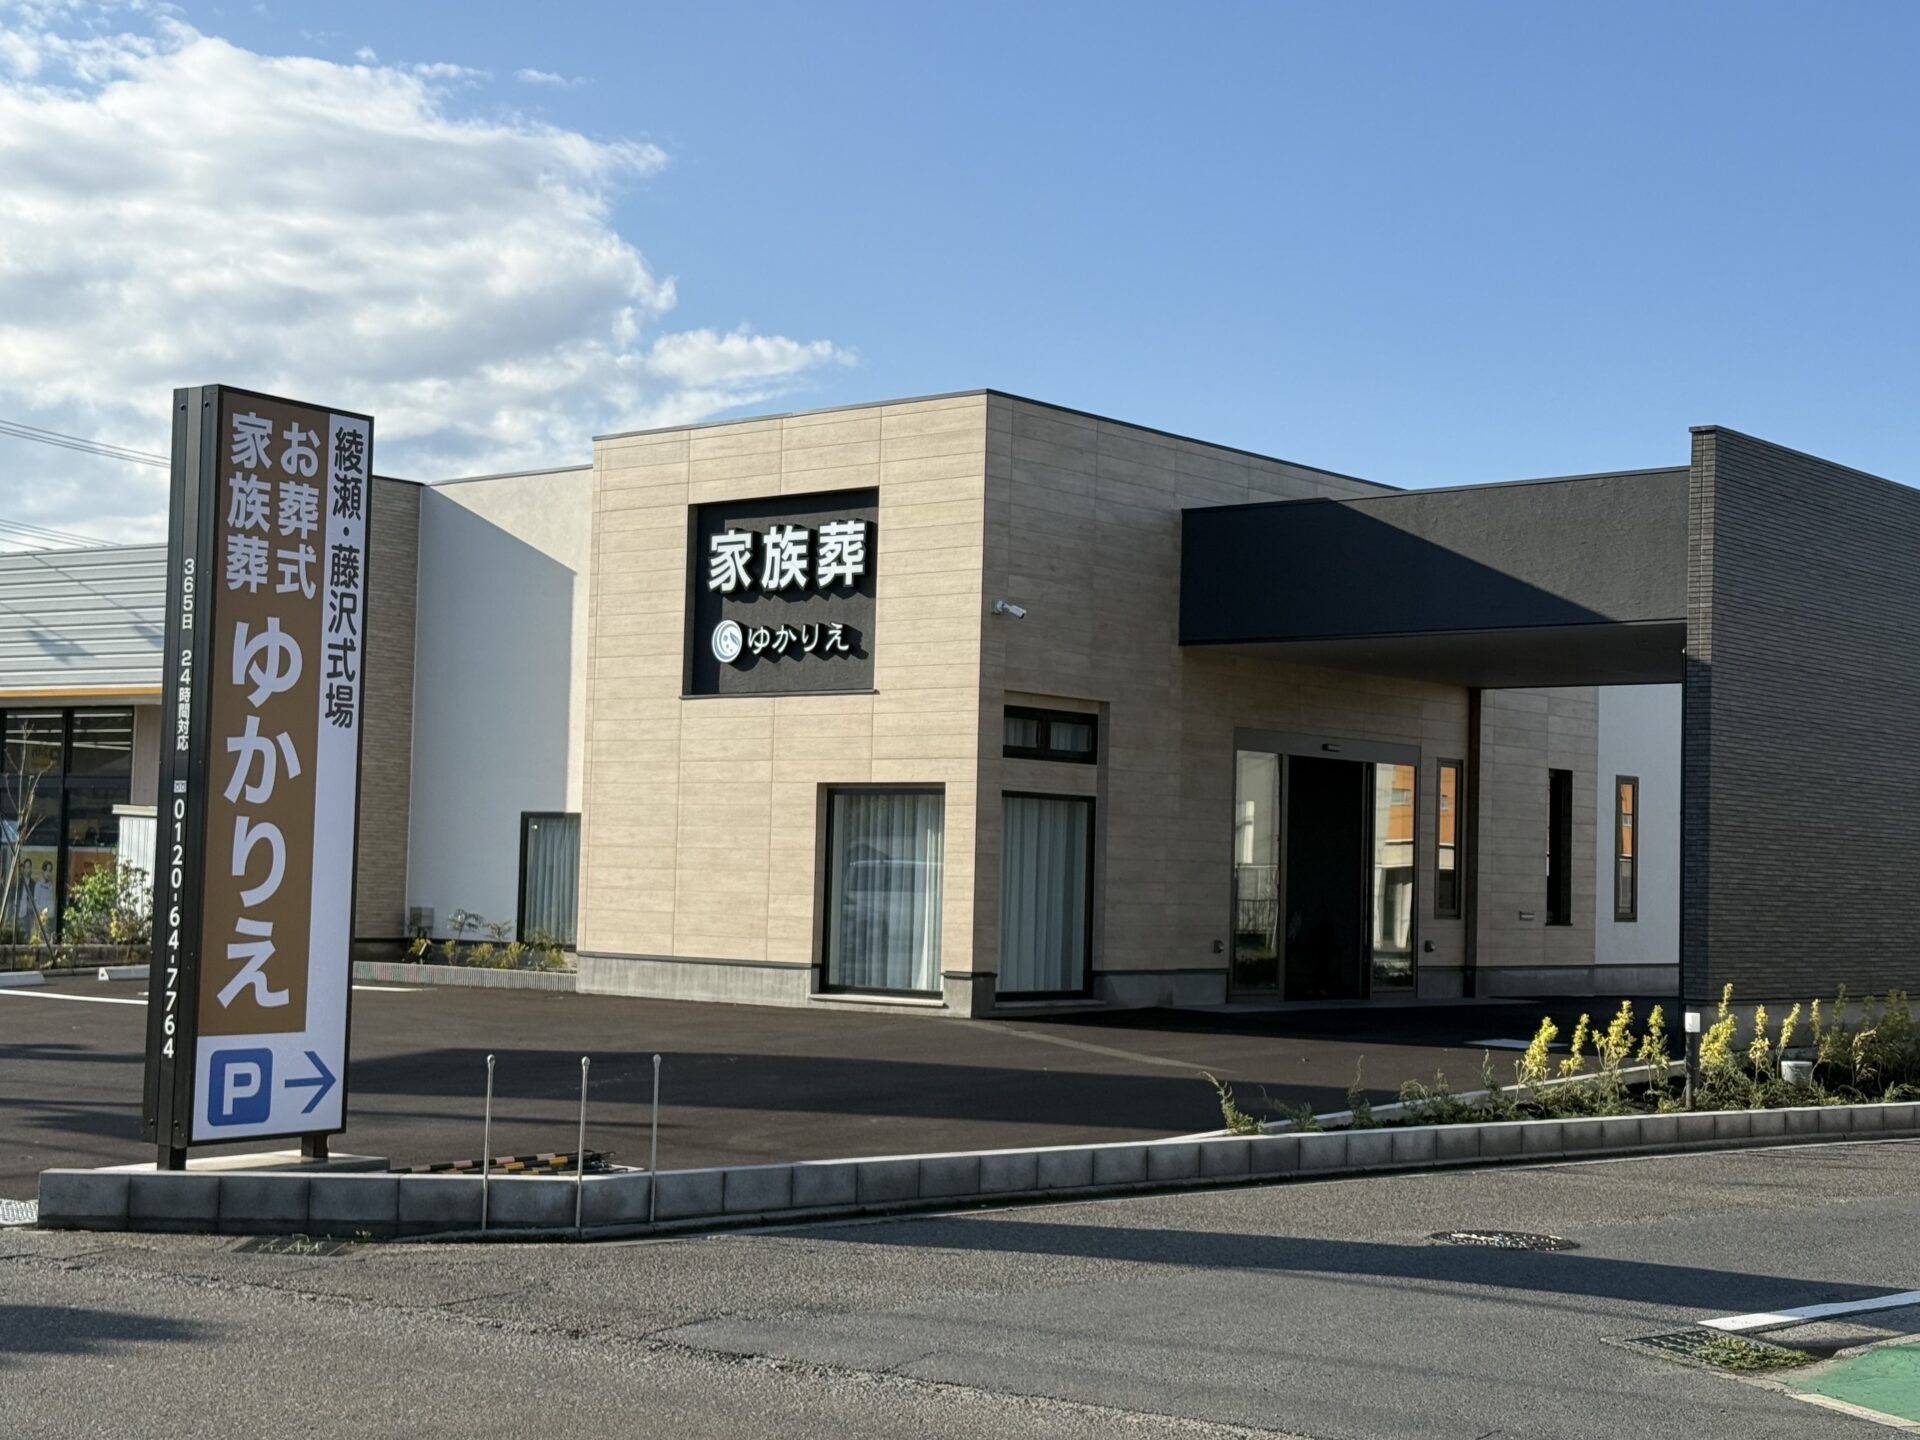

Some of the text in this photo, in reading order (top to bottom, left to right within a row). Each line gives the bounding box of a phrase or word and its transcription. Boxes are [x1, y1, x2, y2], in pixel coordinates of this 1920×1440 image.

[226, 411, 273, 594] 家族葬
[275, 421, 321, 600] お葬式
[324, 426, 365, 729] 綾瀬・藤沢式場
[708, 520, 867, 592] 家族葬
[176, 558, 195, 751] 365日 24時間対応
[747, 622, 850, 655] ゆかりえ
[216, 616, 303, 1008] ゆかりえ
[162, 798, 185, 1058] 0120-64-7764
